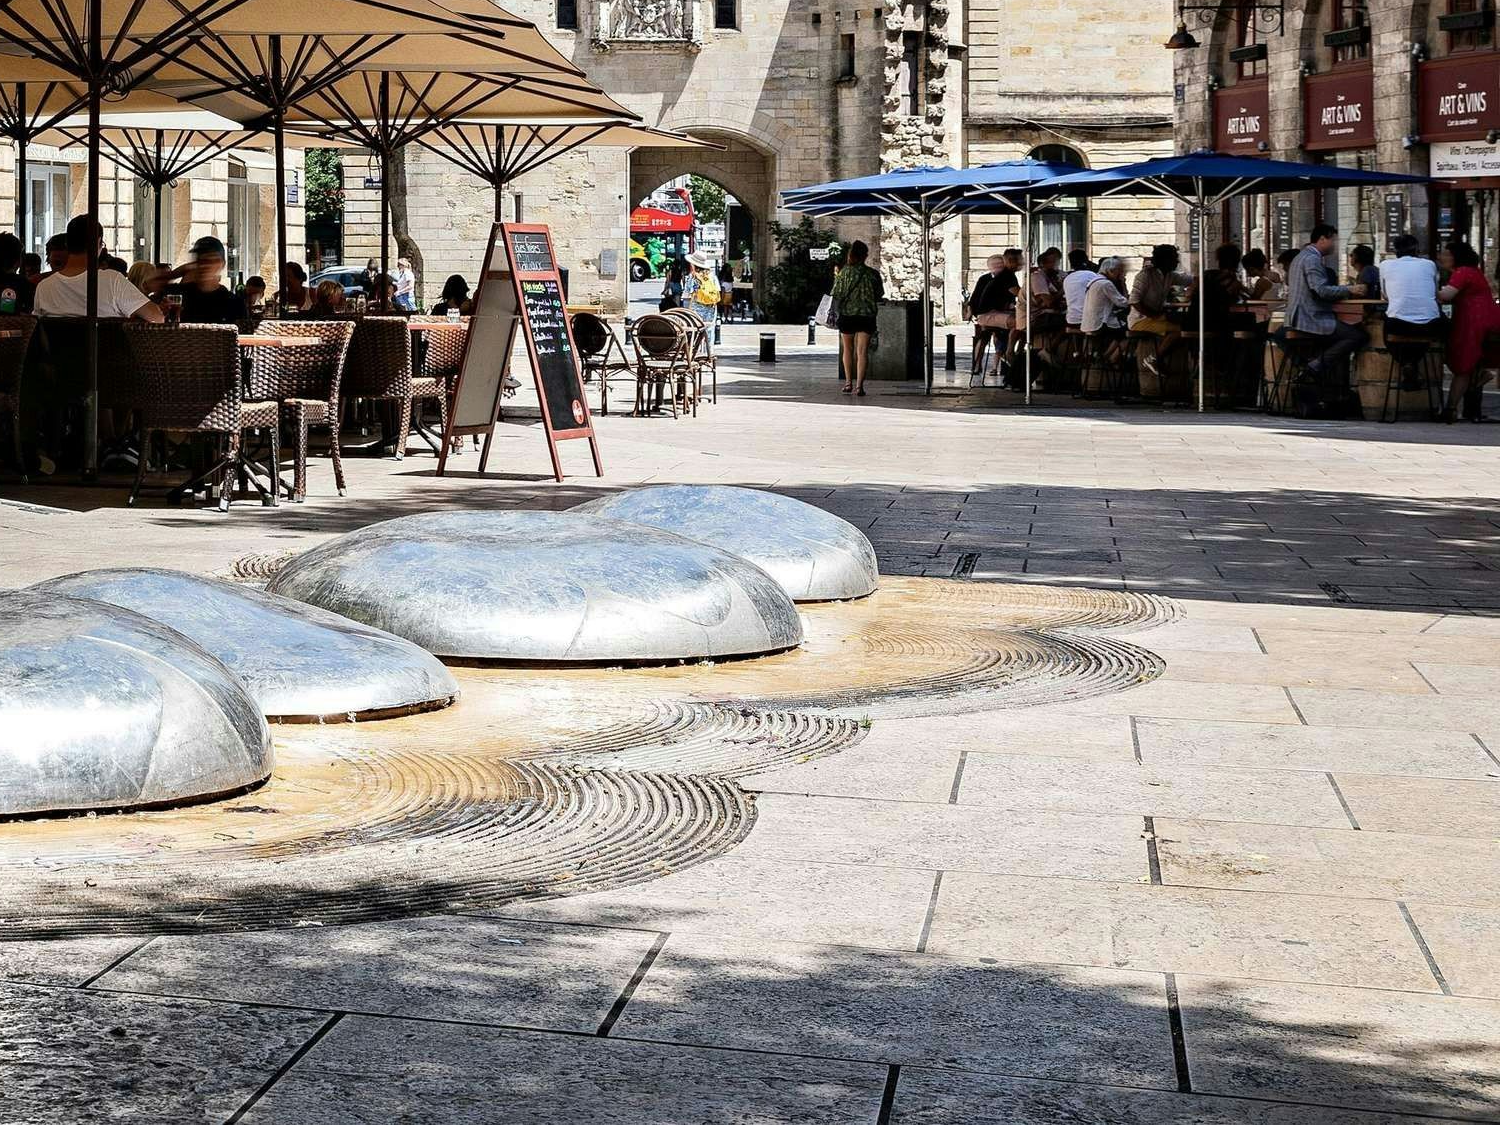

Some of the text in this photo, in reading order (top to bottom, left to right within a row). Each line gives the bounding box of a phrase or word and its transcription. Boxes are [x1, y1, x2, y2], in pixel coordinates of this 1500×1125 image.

[1321, 103, 1361, 126] ART & VINS
[1439, 91, 1487, 116] ART & VINS
[1227, 115, 1261, 135] ART & VINS
